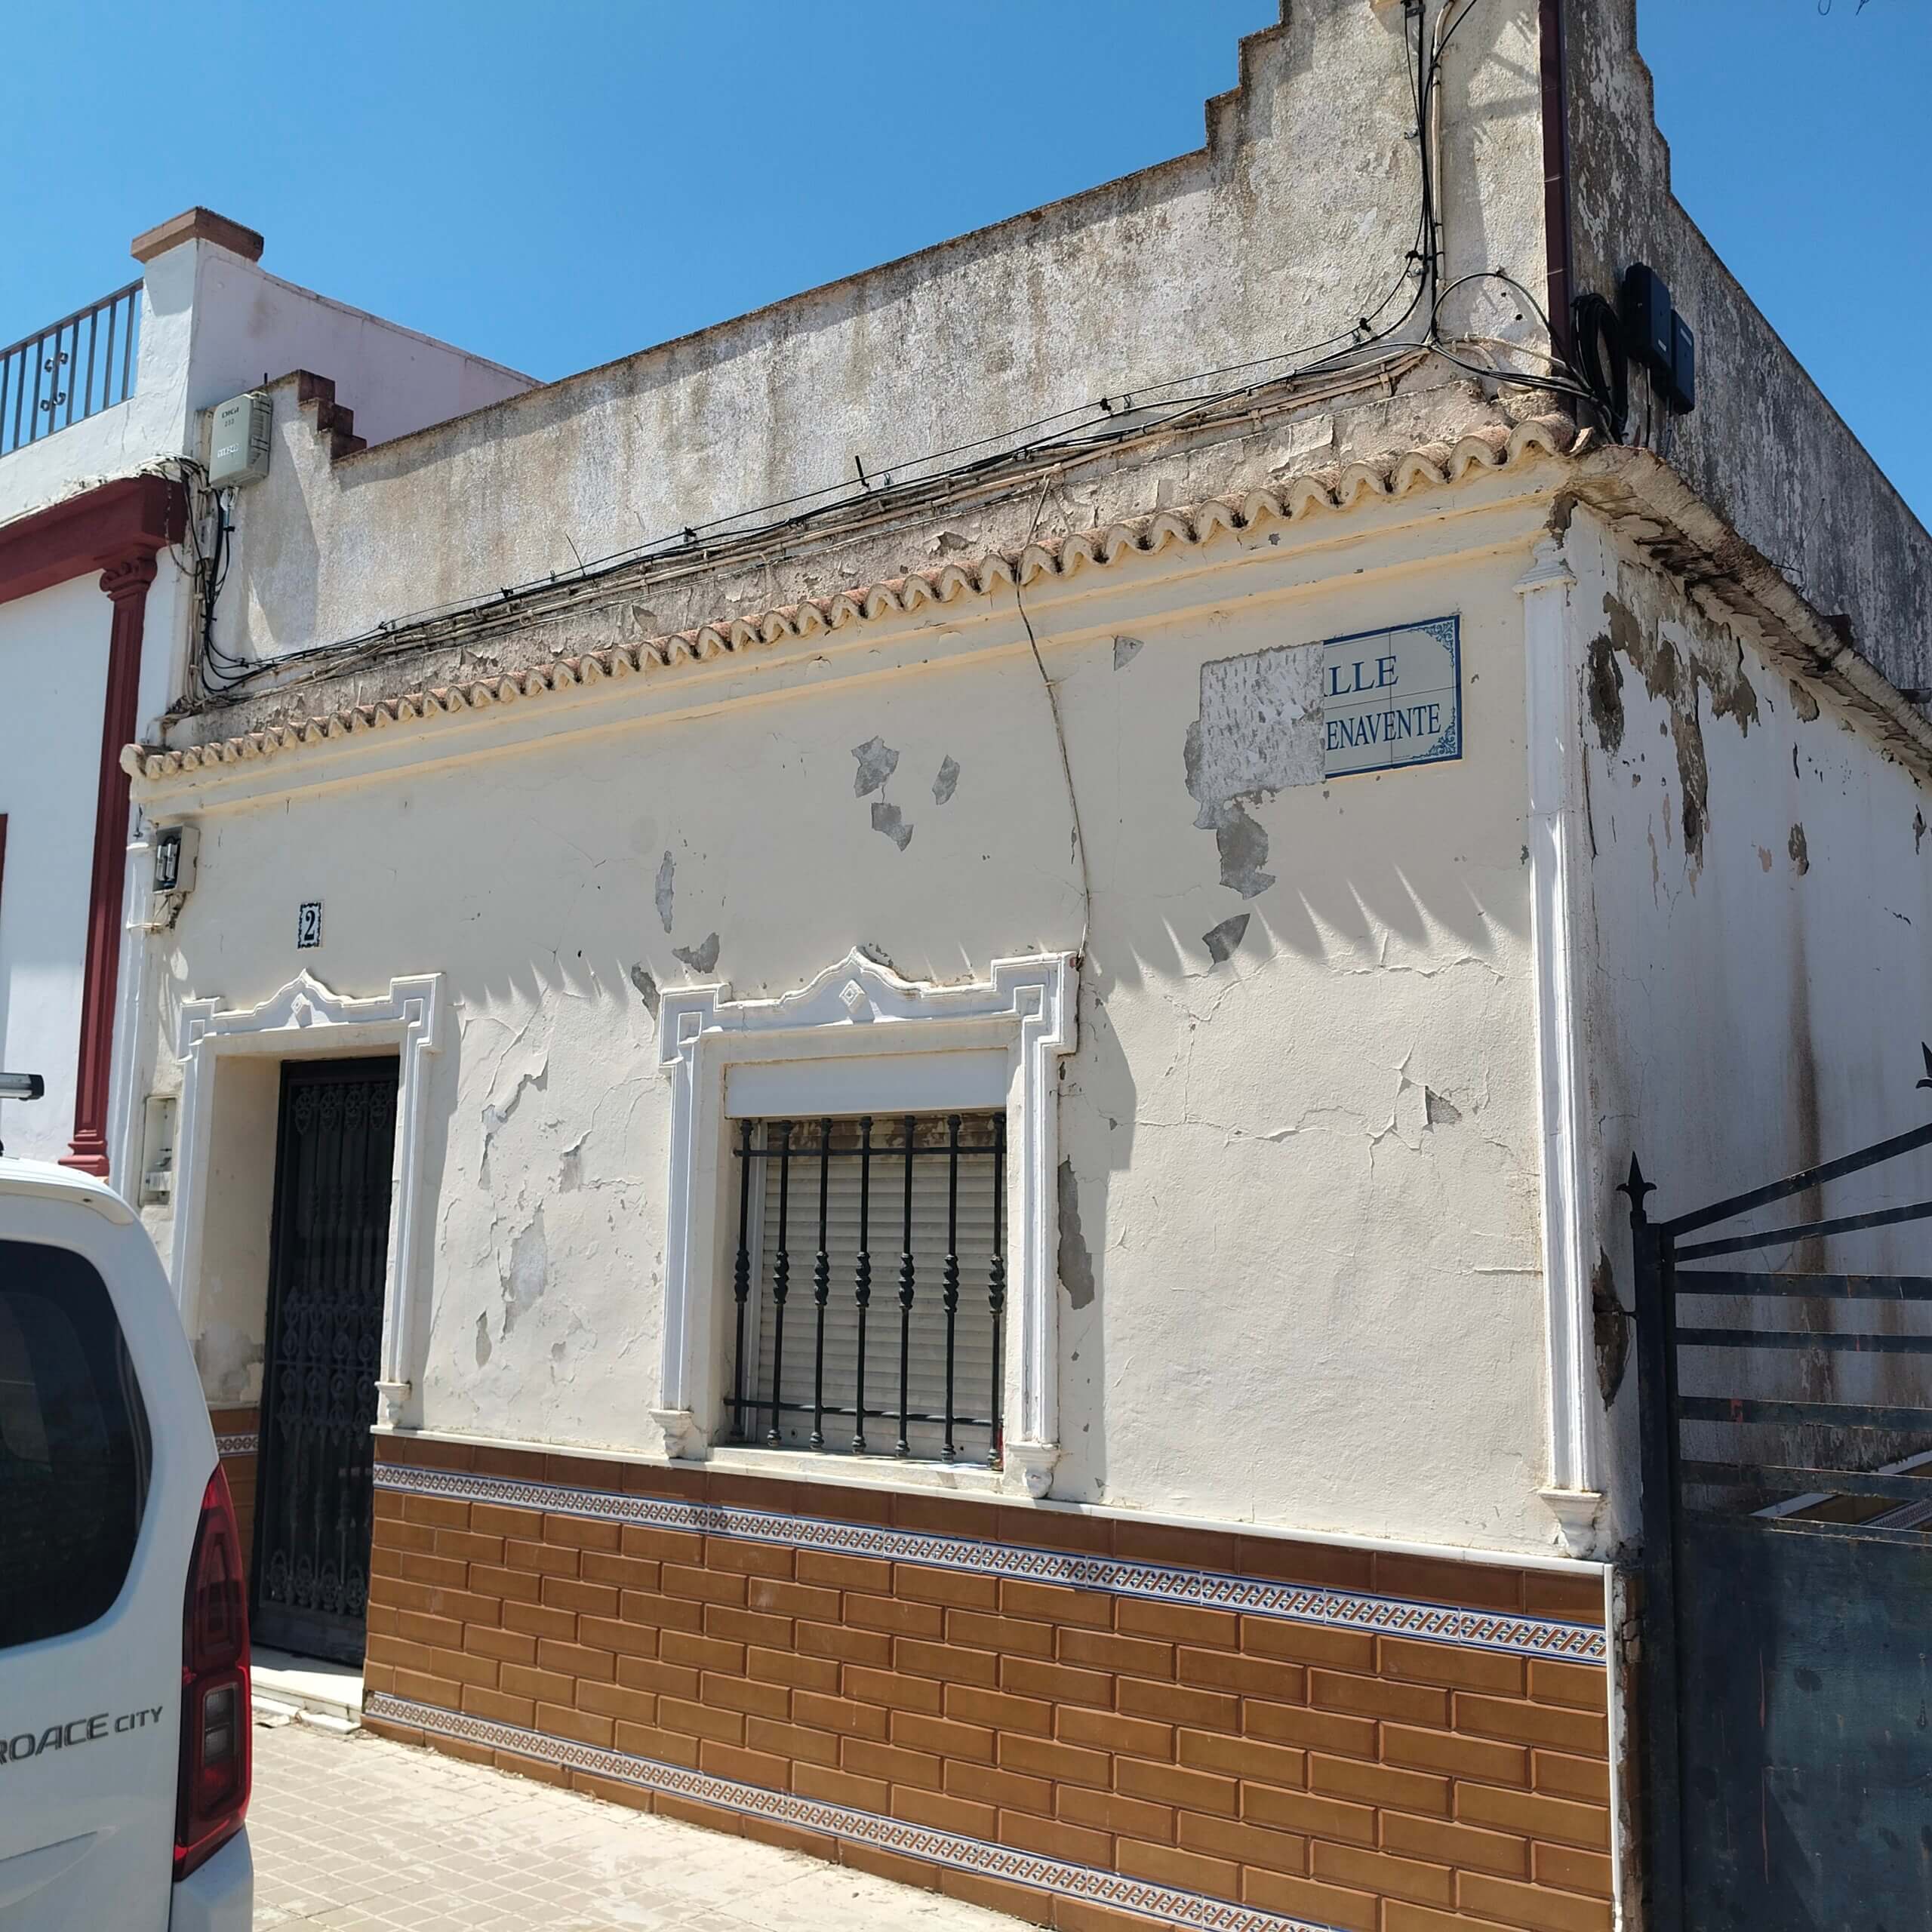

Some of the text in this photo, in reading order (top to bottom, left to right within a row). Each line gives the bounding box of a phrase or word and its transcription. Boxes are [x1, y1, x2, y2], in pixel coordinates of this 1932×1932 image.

[222, 406, 239, 419] DIGI
[1324, 655, 1399, 697] LLE
[1326, 703, 1441, 750] ENAVENTE
[304, 910, 315, 941] 2
[115, 1706, 163, 1733] CITY
